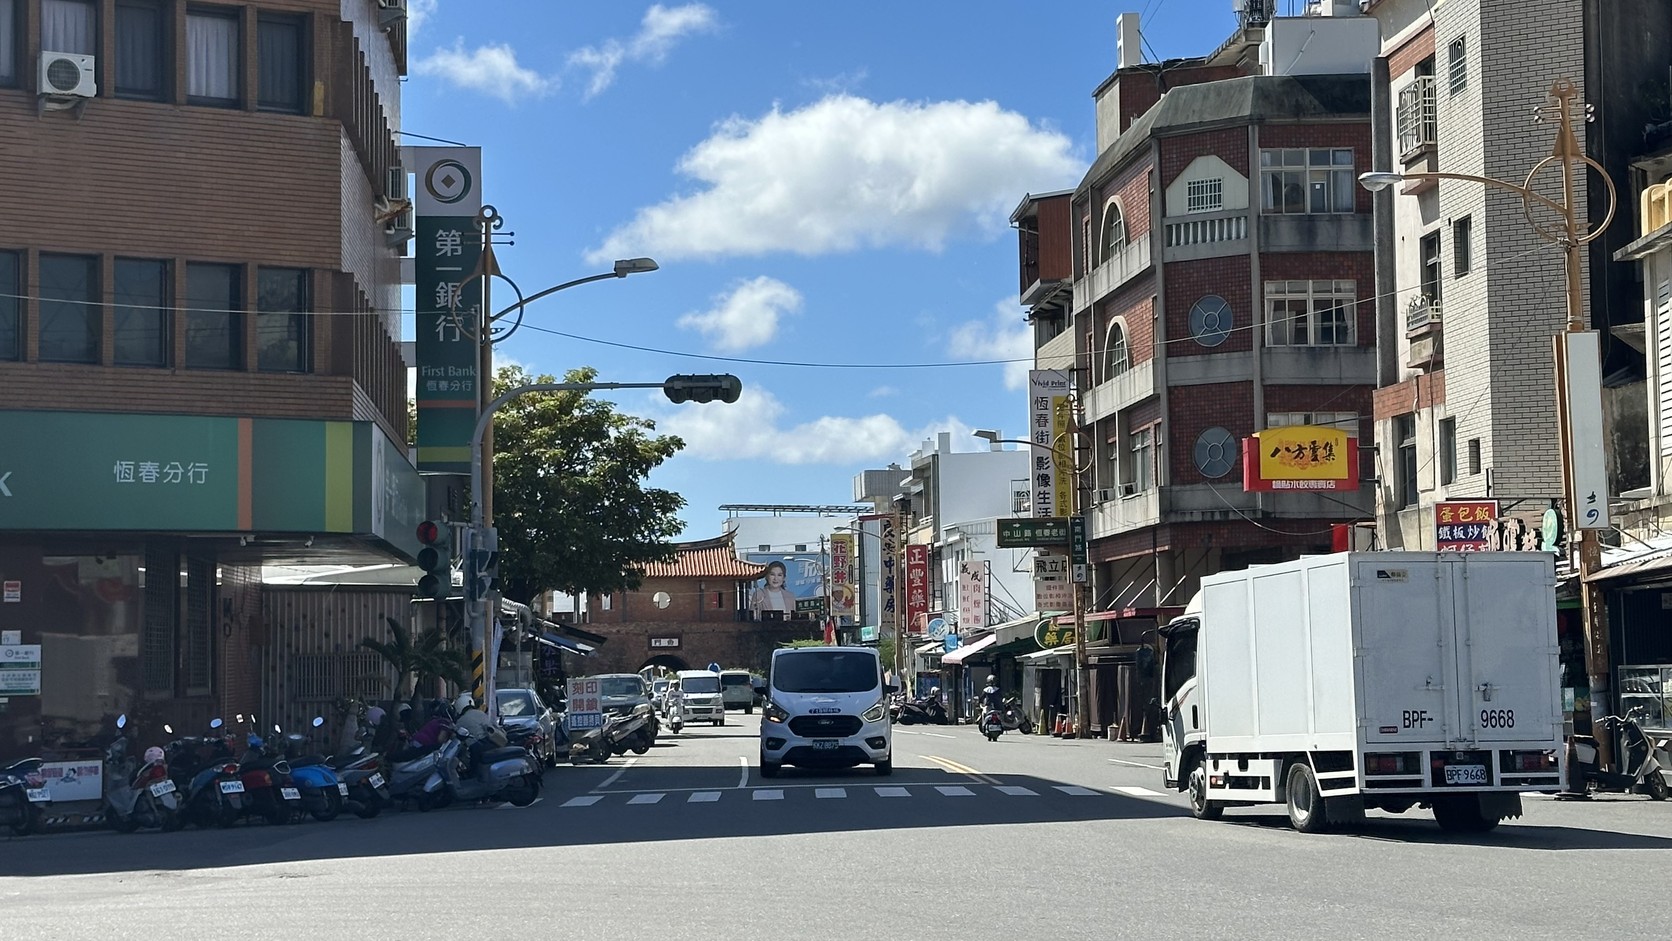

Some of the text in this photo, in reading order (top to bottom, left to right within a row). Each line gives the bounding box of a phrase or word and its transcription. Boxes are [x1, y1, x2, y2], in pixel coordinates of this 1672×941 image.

[435, 229, 463, 342] 第一銀行
[421, 365, 476, 377] First Bank
[426, 380, 472, 392] 恆春分行
[1034, 396, 1050, 445] 恆春街
[1270, 440, 1336, 462] 八方雲集
[113, 460, 209, 484] 恆春分行
[1035, 456, 1052, 518] 影像生活
[1439, 507, 1491, 523] 蛋包飯
[1003, 529, 1031, 538] 中山路
[1074, 525, 1083, 552] 南門路
[572, 681, 598, 695] 刻印
[572, 697, 599, 712] 開鎖
[1480, 709, 1515, 729] 9668
